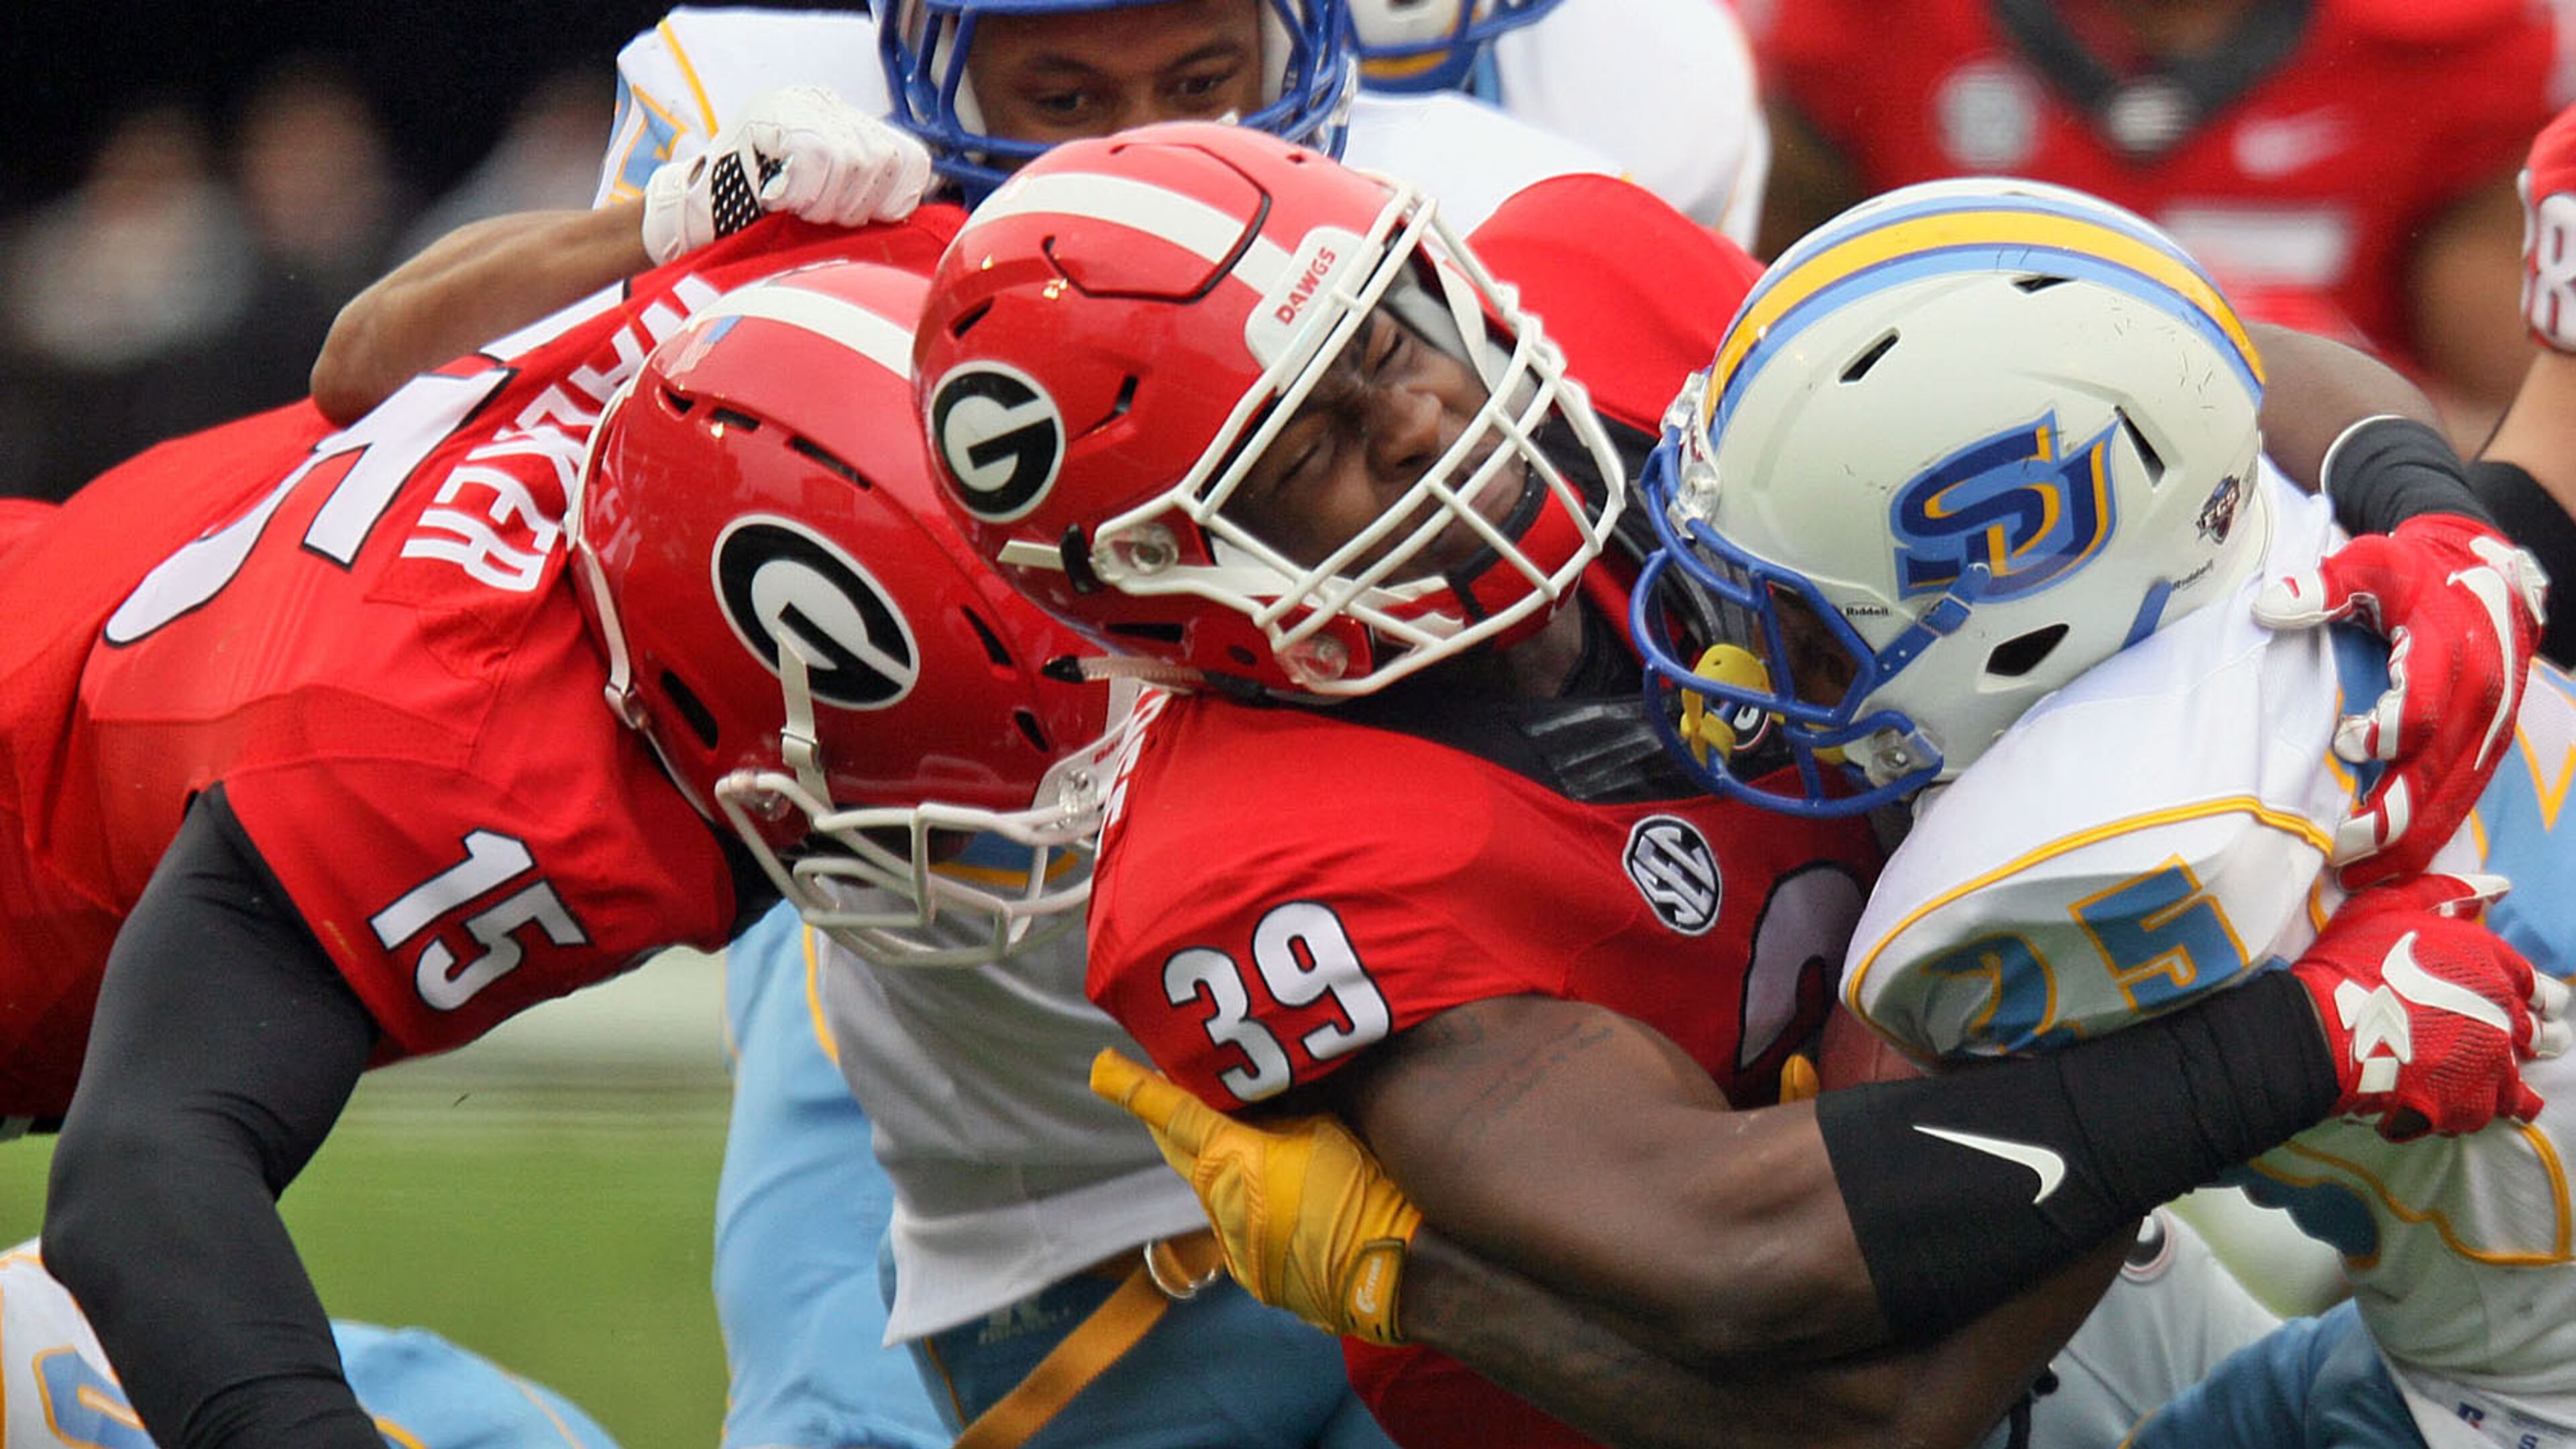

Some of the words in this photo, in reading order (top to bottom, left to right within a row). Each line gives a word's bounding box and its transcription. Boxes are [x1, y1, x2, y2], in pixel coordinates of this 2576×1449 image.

[1275, 246, 1336, 325] DAWGS
[928, 361, 1064, 522] G
[712, 515, 918, 709] G
[1845, 606, 1889, 616] Riddell
[369, 826, 593, 1011] 15
[1631, 825, 1716, 926] SEC
[1163, 899, 1391, 1102] 39
